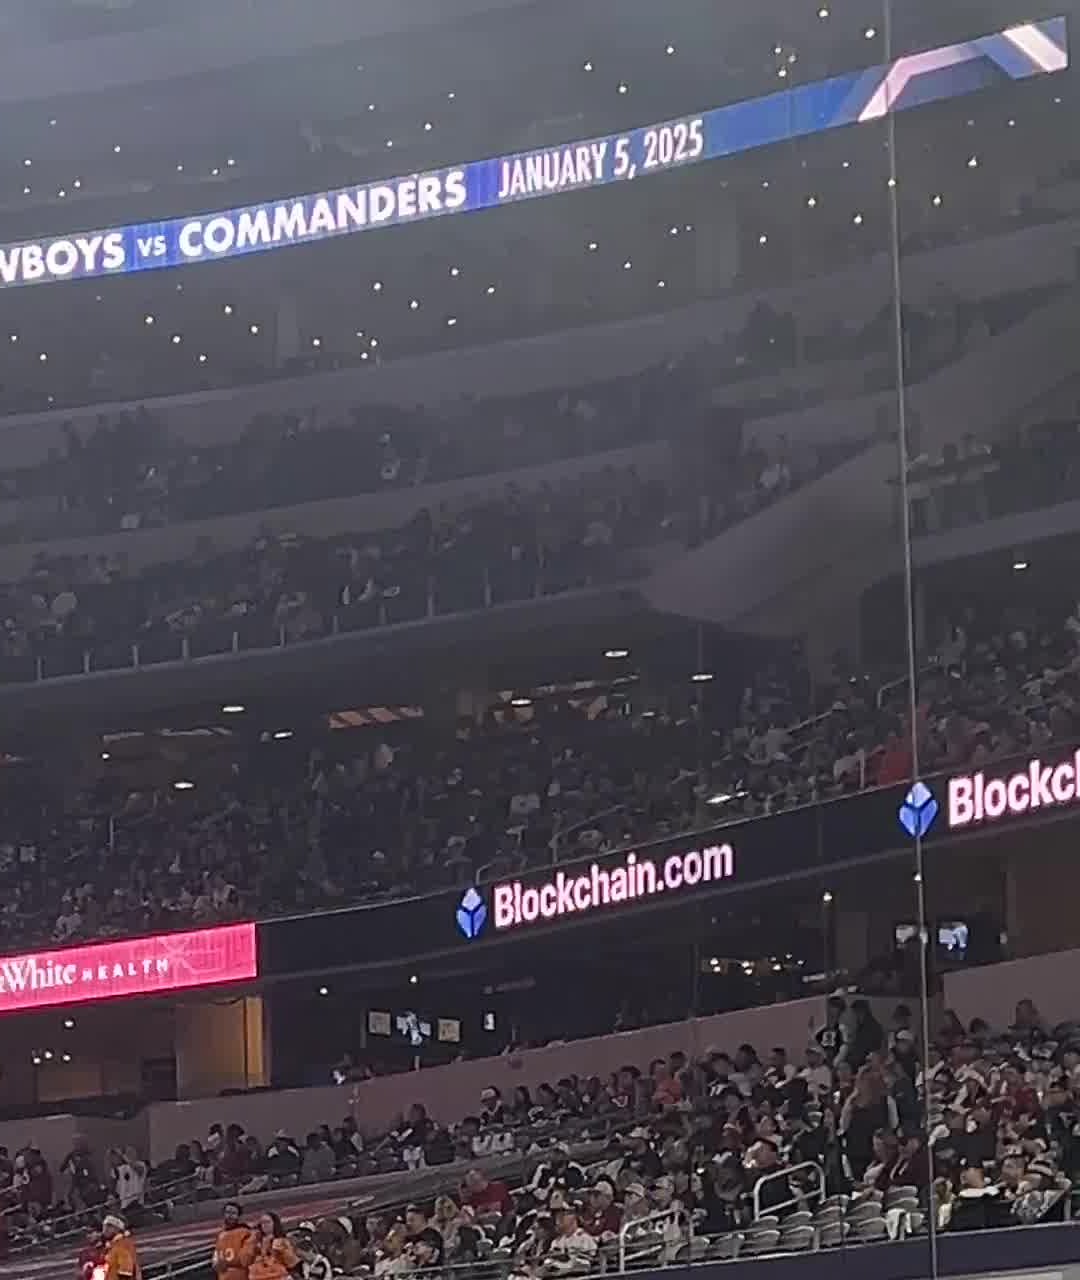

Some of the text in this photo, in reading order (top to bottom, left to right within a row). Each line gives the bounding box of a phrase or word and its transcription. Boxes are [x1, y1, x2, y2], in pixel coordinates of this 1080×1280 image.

[178, 171, 467, 256] COMMANDERS
[499, 142, 607, 197] JANUARY
[614, 138, 636, 179] 5,
[643, 119, 704, 168] 2025
[494, 841, 734, 928] Blockchain.com
[81, 958, 169, 982] HEALTH
